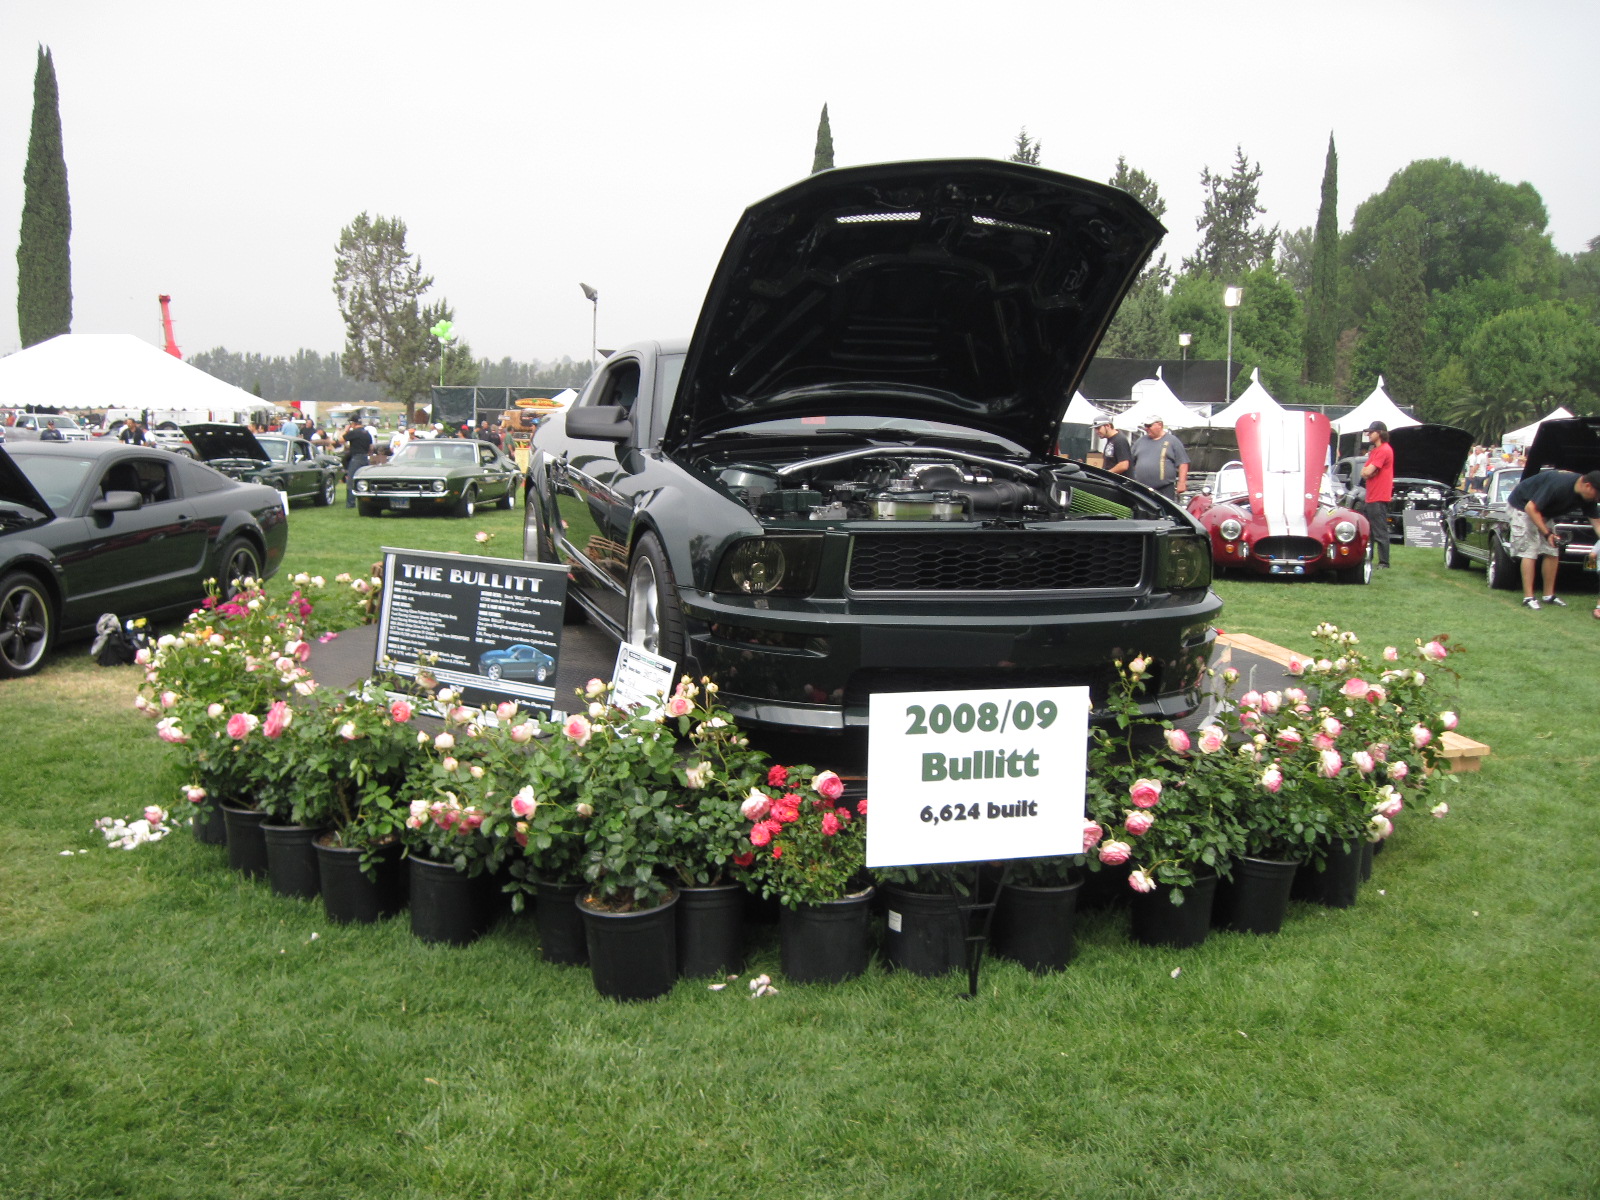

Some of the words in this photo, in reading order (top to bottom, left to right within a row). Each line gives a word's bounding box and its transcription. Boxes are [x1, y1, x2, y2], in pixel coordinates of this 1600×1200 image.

[402, 563, 443, 581] THE
[449, 568, 543, 592] BULLITT
[904, 699, 1058, 735] 2008/09
[921, 747, 1040, 782] Bullitt
[920, 802, 981, 826] 6,624
[987, 799, 1038, 819] built
